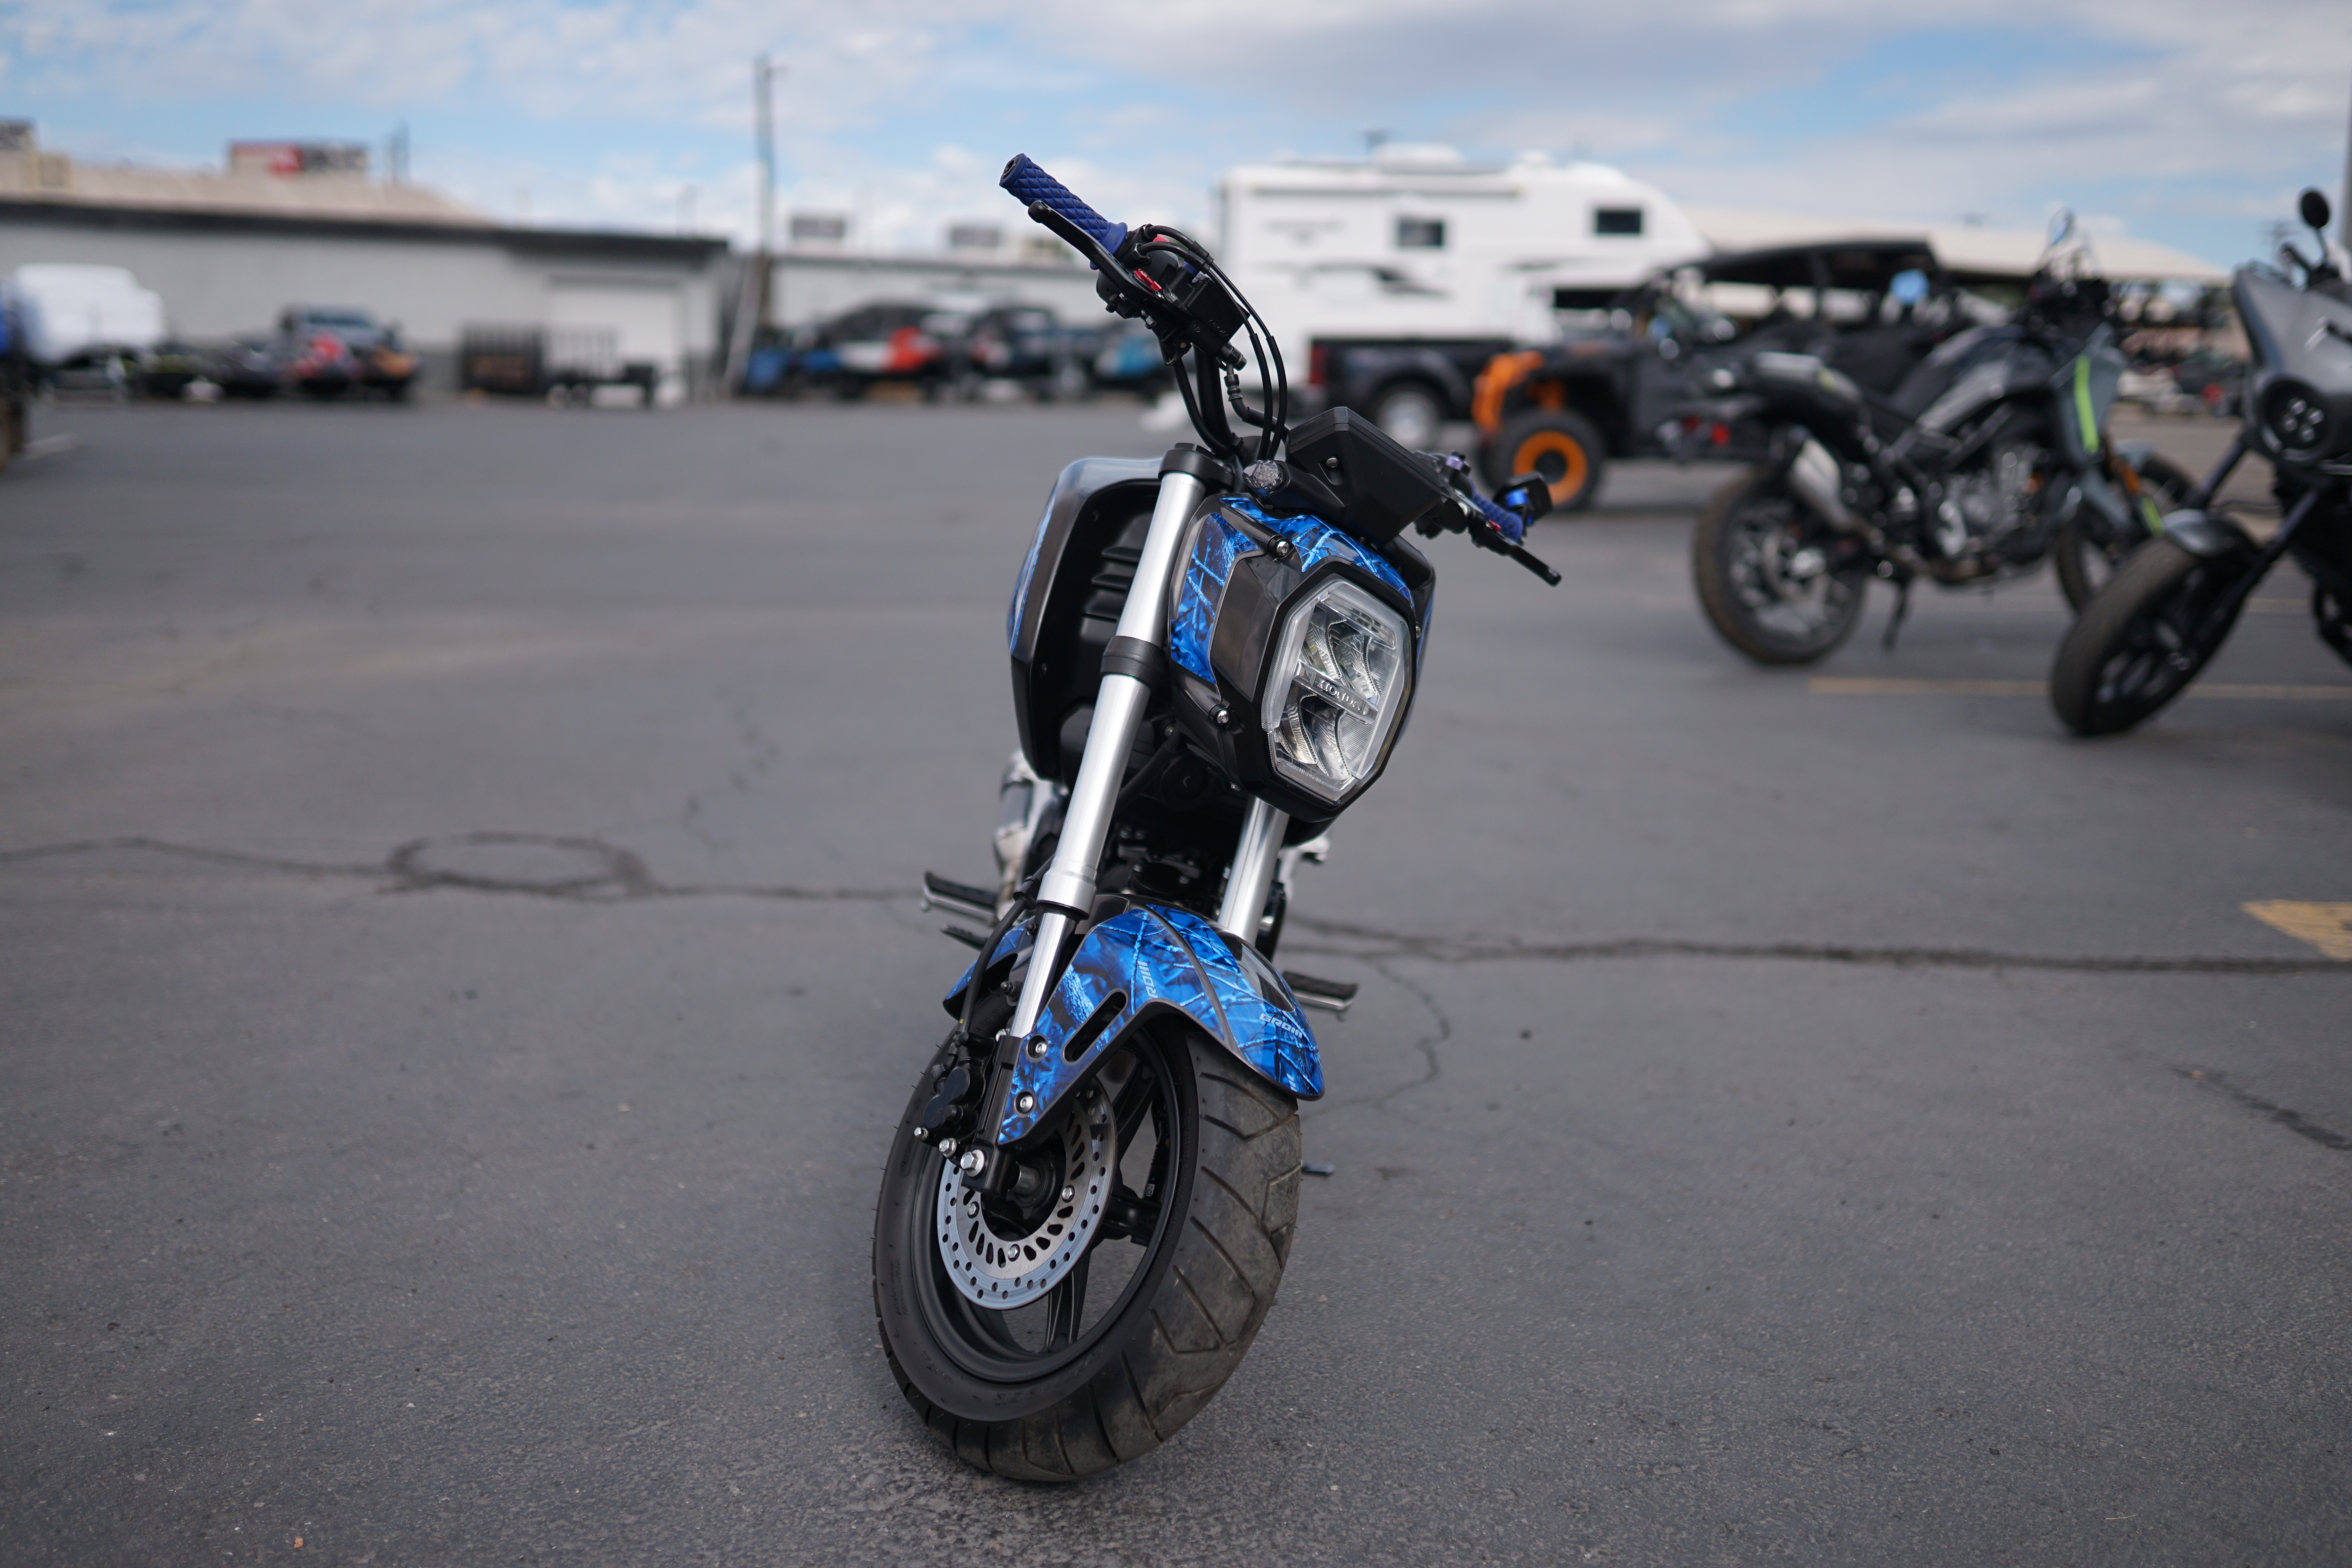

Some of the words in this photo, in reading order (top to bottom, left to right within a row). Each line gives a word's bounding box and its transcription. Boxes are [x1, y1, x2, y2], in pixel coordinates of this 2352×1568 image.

[1318, 679, 1362, 711] HONDA
[1137, 960, 1158, 999] ROM
[1259, 1013, 1303, 1039] GROM
